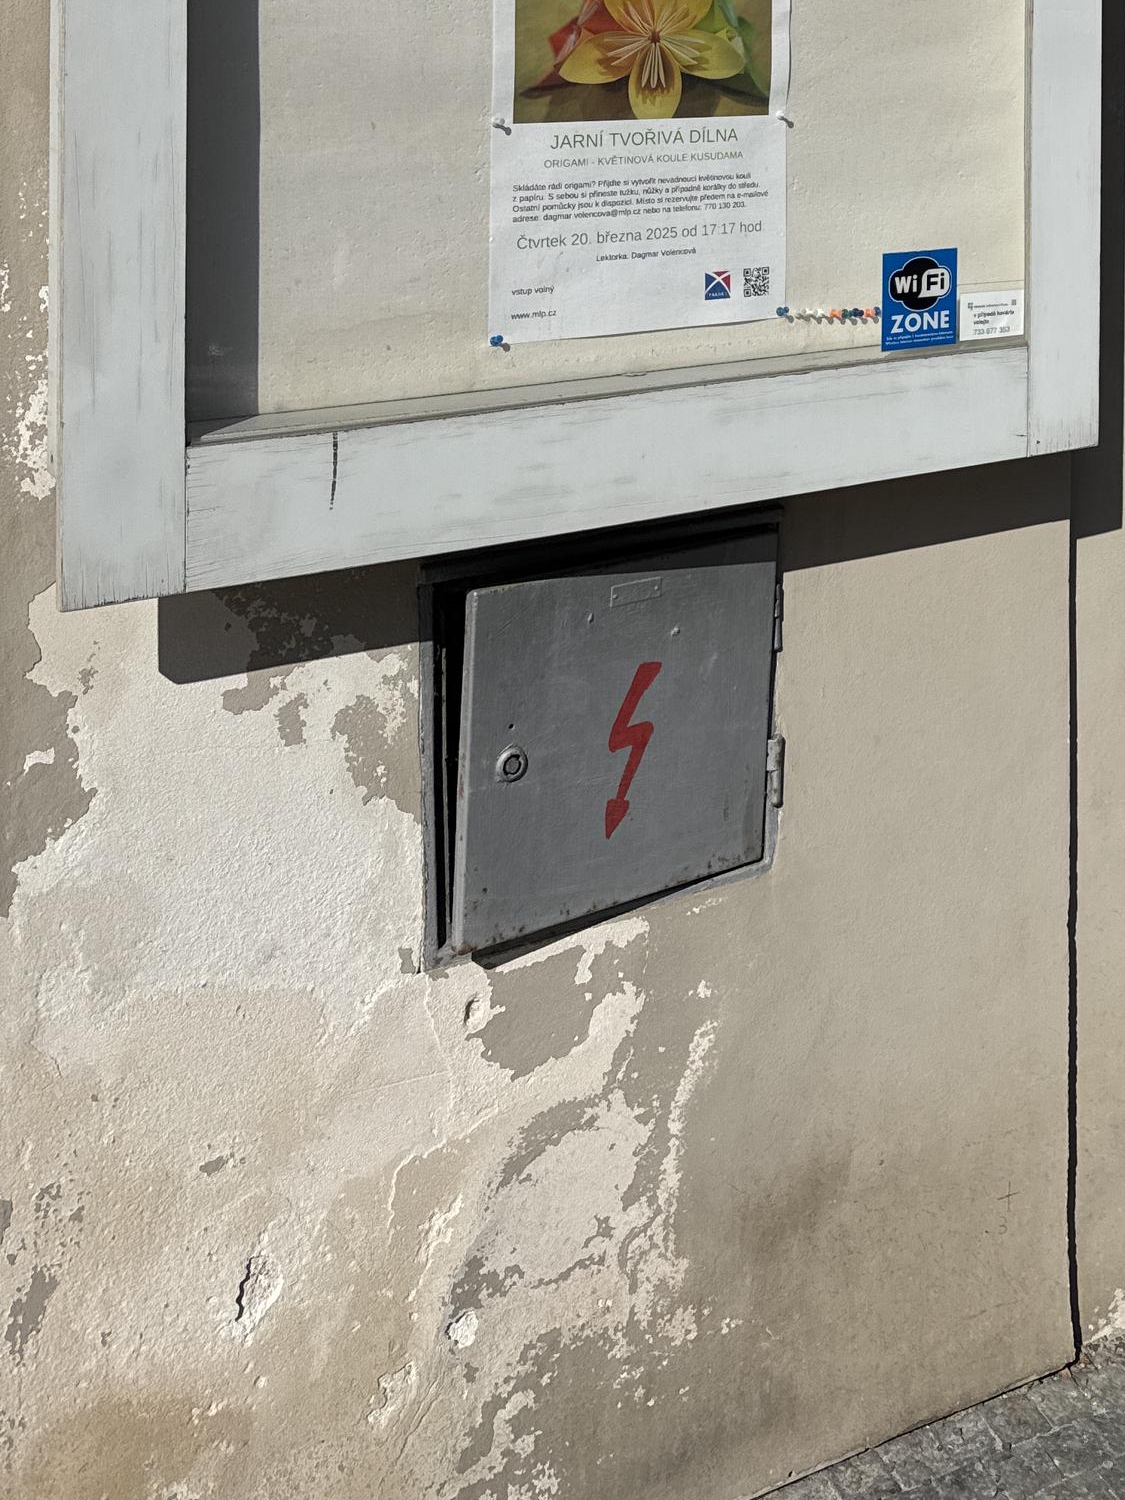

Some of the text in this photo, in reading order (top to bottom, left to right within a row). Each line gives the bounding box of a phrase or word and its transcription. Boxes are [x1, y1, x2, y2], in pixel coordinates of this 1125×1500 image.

[550, 126, 738, 150] JARNÍ TVOŘIVÁ DÍLNA
[543, 151, 744, 169] ORIGAMI KVĚTINOVÁ KOULE KUSUDAMA
[513, 203, 540, 212] Ostatní
[516, 232, 567, 250] Čtvrtek
[571, 232, 592, 246] 20.
[597, 228, 642, 245] března
[646, 226, 678, 241] 2025
[682, 225, 697, 238] od
[702, 221, 736, 237] 17:17
[631, 250, 660, 261] Dagmar
[511, 287, 533, 297] vstup
[891, 310, 950, 334] ZONE
